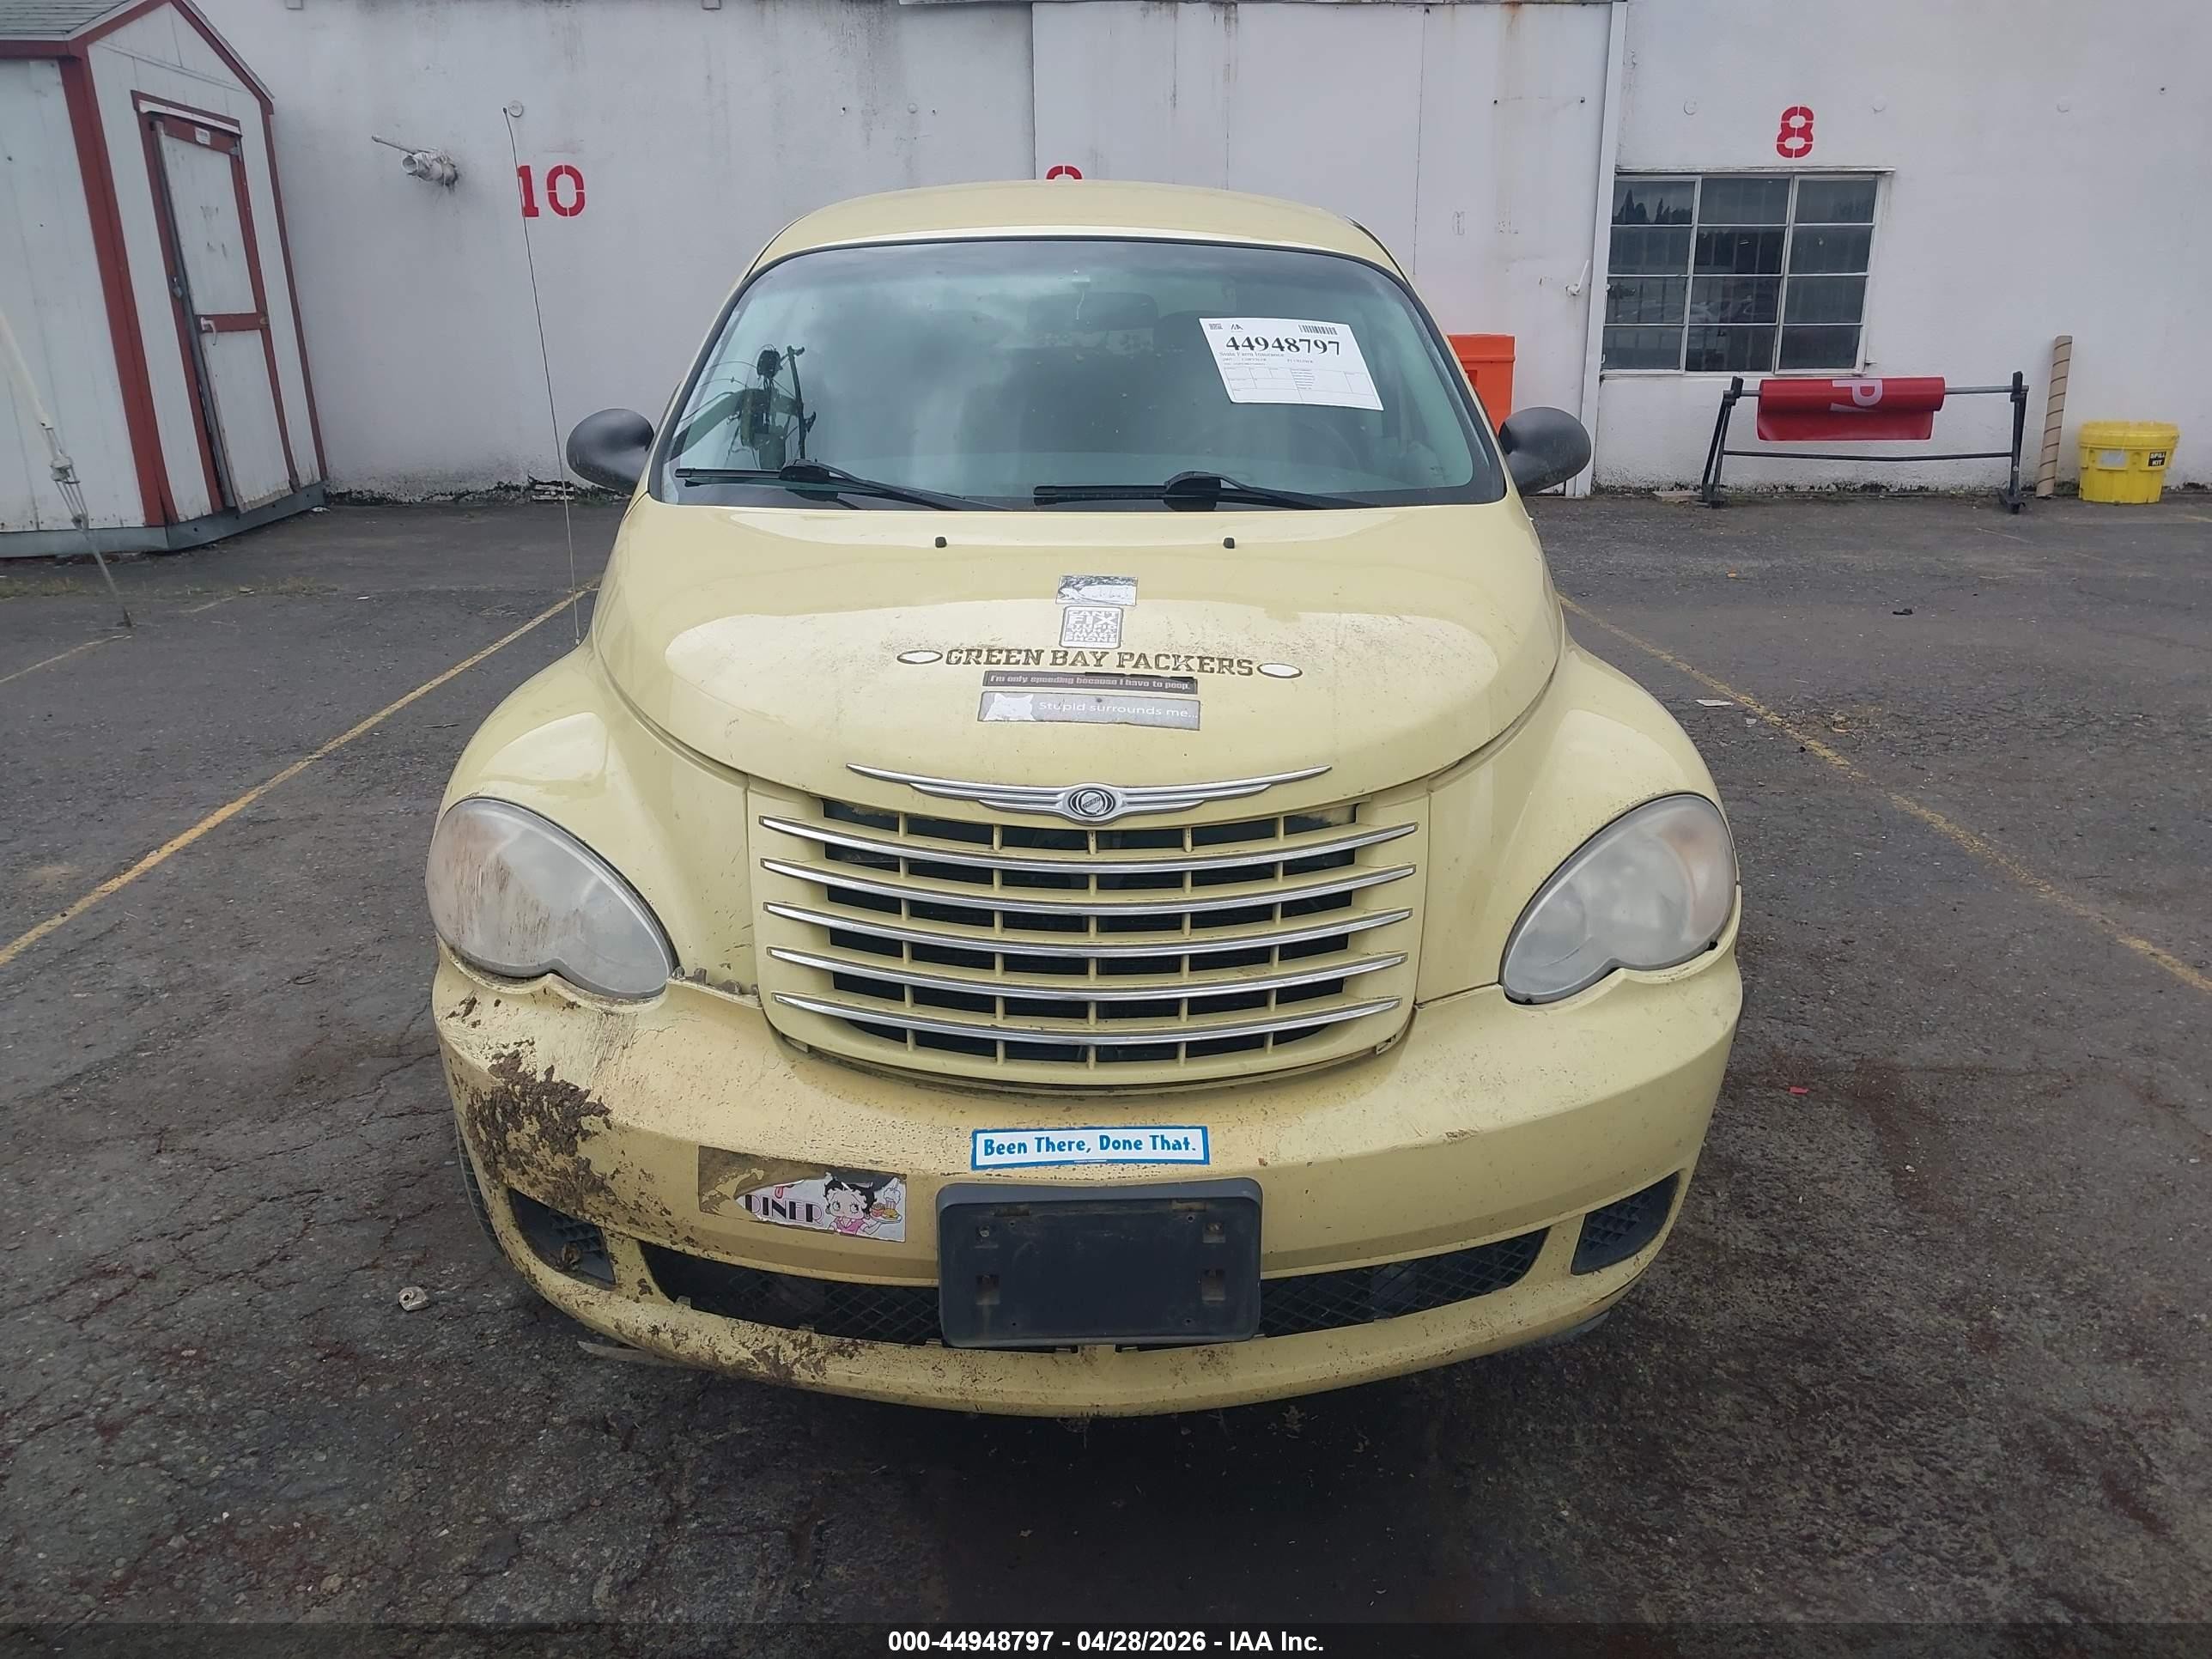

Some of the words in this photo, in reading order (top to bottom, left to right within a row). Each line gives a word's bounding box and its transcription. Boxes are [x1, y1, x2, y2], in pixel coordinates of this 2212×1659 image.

[1777, 106, 1814, 158] 8
[517, 165, 586, 217] 10
[1226, 336, 1340, 356] 44948797
[1068, 615, 1116, 625] FIX
[945, 649, 1044, 665] GREEN
[1049, 650, 1109, 667] BAY
[1116, 651, 1254, 677] PACKERS
[1007, 675, 1028, 684] only
[1038, 701, 1085, 713] Stupid
[1090, 702, 1162, 715] surrounds
[983, 1138, 1028, 1156] Been
[1034, 1136, 1091, 1153] There,
[1098, 1134, 1143, 1151] Done
[1149, 1134, 1196, 1151] That.
[745, 1194, 824, 1225] DINER
